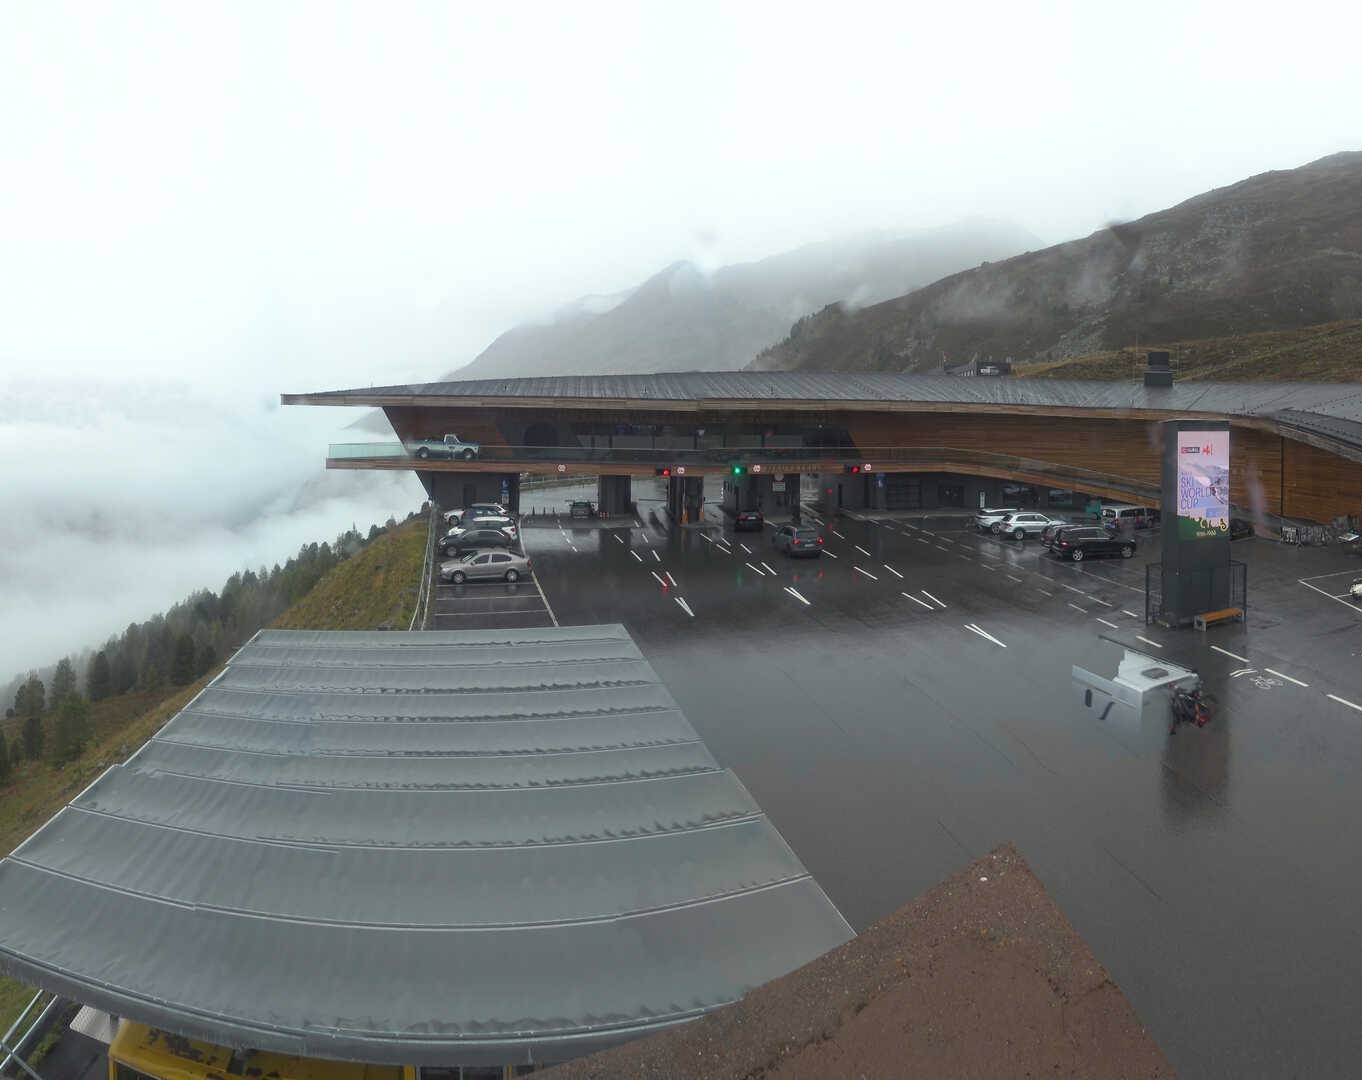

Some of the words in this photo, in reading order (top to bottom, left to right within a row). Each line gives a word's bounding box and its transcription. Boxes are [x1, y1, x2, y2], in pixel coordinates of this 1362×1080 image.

[1181, 477, 1193, 488] SKI
[1181, 488, 1212, 498] WORLD
[1181, 499, 1199, 510] CUP
